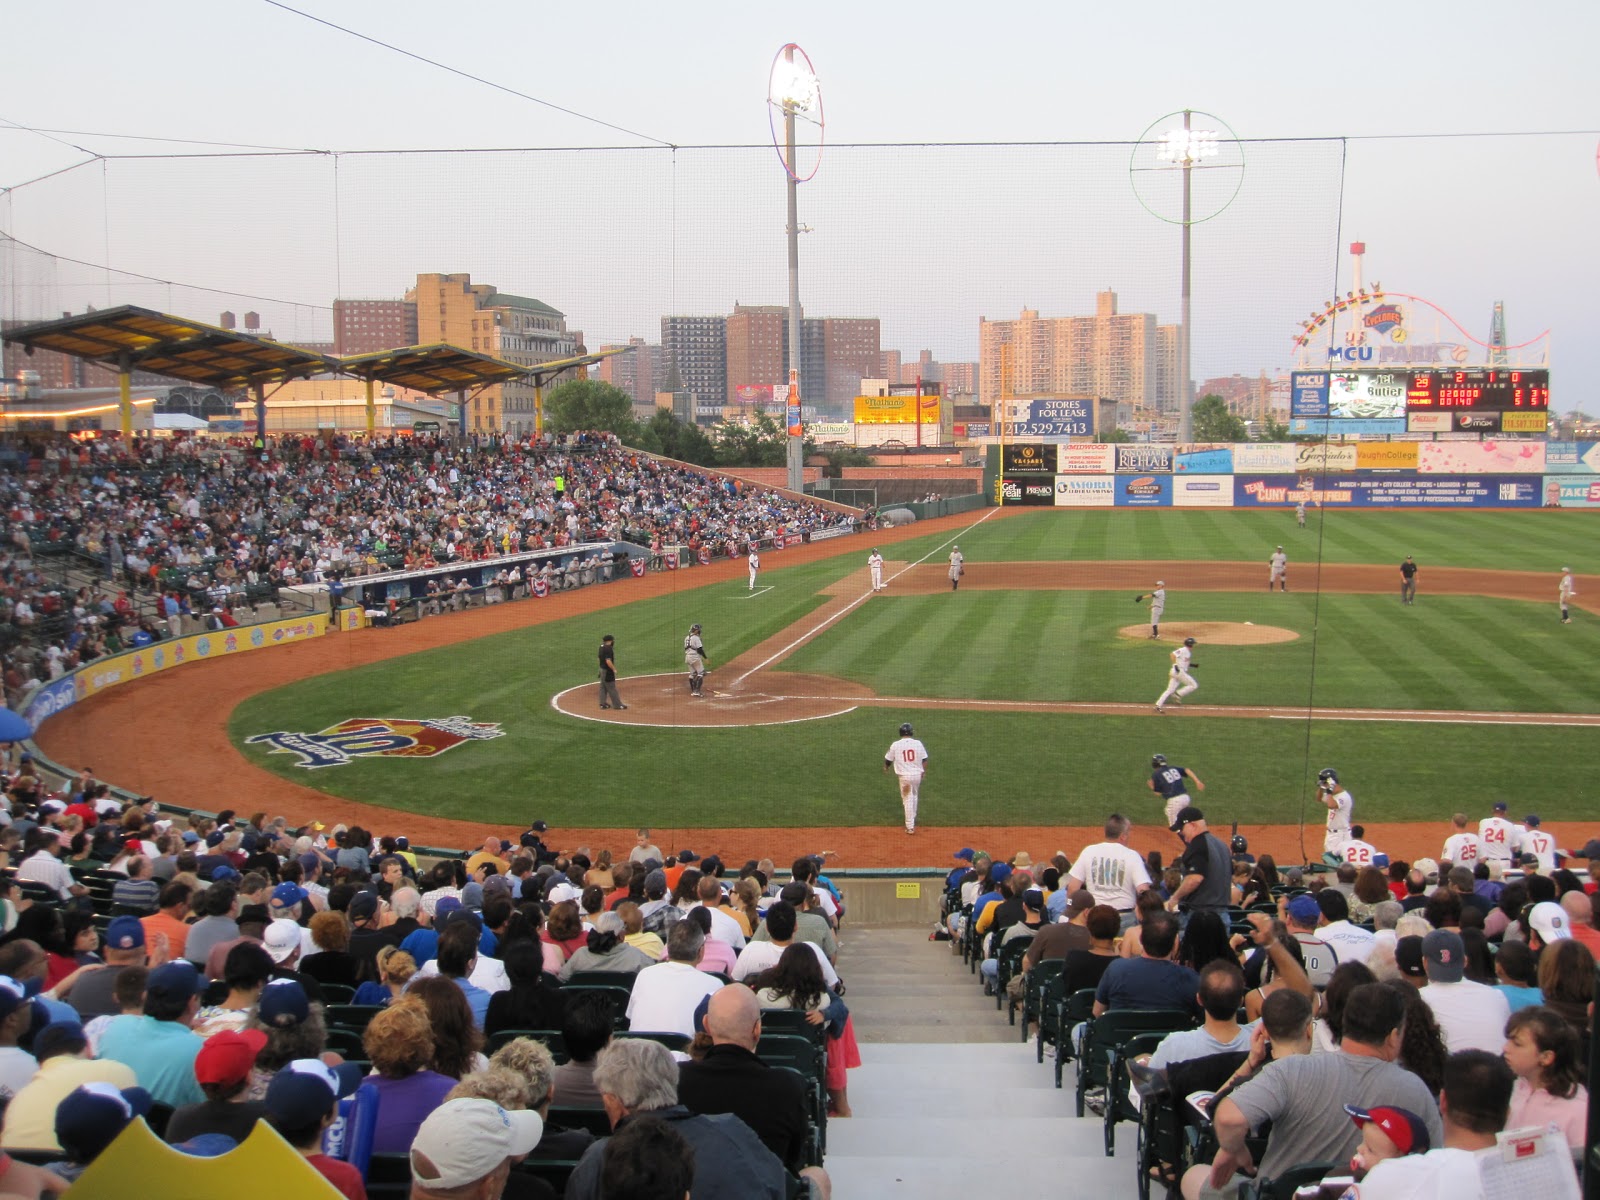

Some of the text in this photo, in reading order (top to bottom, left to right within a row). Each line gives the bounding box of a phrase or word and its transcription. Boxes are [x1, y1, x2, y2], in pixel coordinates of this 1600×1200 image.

[1364, 312, 1401, 327] CYCLONES
[1328, 344, 1441, 362] MCU PARK
[1296, 376, 1324, 385] MCU
[1456, 372, 1463, 382] 2
[1512, 372, 1519, 382] 0
[1416, 378, 1429, 388] 29
[865, 398, 906, 408] Nathan's
[1046, 401, 1080, 409] STORES
[811, 425, 850, 434] Nathan's
[1006, 423, 1086, 434] 212.529.7413
[1120, 449, 1167, 457] LANDMARK
[1358, 452, 1417, 460] VaughnCollege
[1120, 456, 1169, 467] REHAB
[1002, 482, 1017, 490] Get
[1026, 486, 1052, 494] PREMIO
[1244, 481, 1265, 494] TEAM
[1501, 484, 1511, 492] CU
[1561, 485, 1600, 498] TAKE 5
[1002, 488, 1022, 498] real!
[1257, 488, 1287, 502] CUNY
[1288, 491, 1311, 502] TAKES
[1501, 492, 1510, 500] NY
[902, 749, 915, 762] 10
[1485, 828, 1505, 844] 24
[1533, 839, 1548, 854] 17
[1347, 847, 1369, 862] 22
[1461, 844, 1477, 861] 25
[1440, 949, 1451, 963] B
[327, 1116, 345, 1157] MCU
